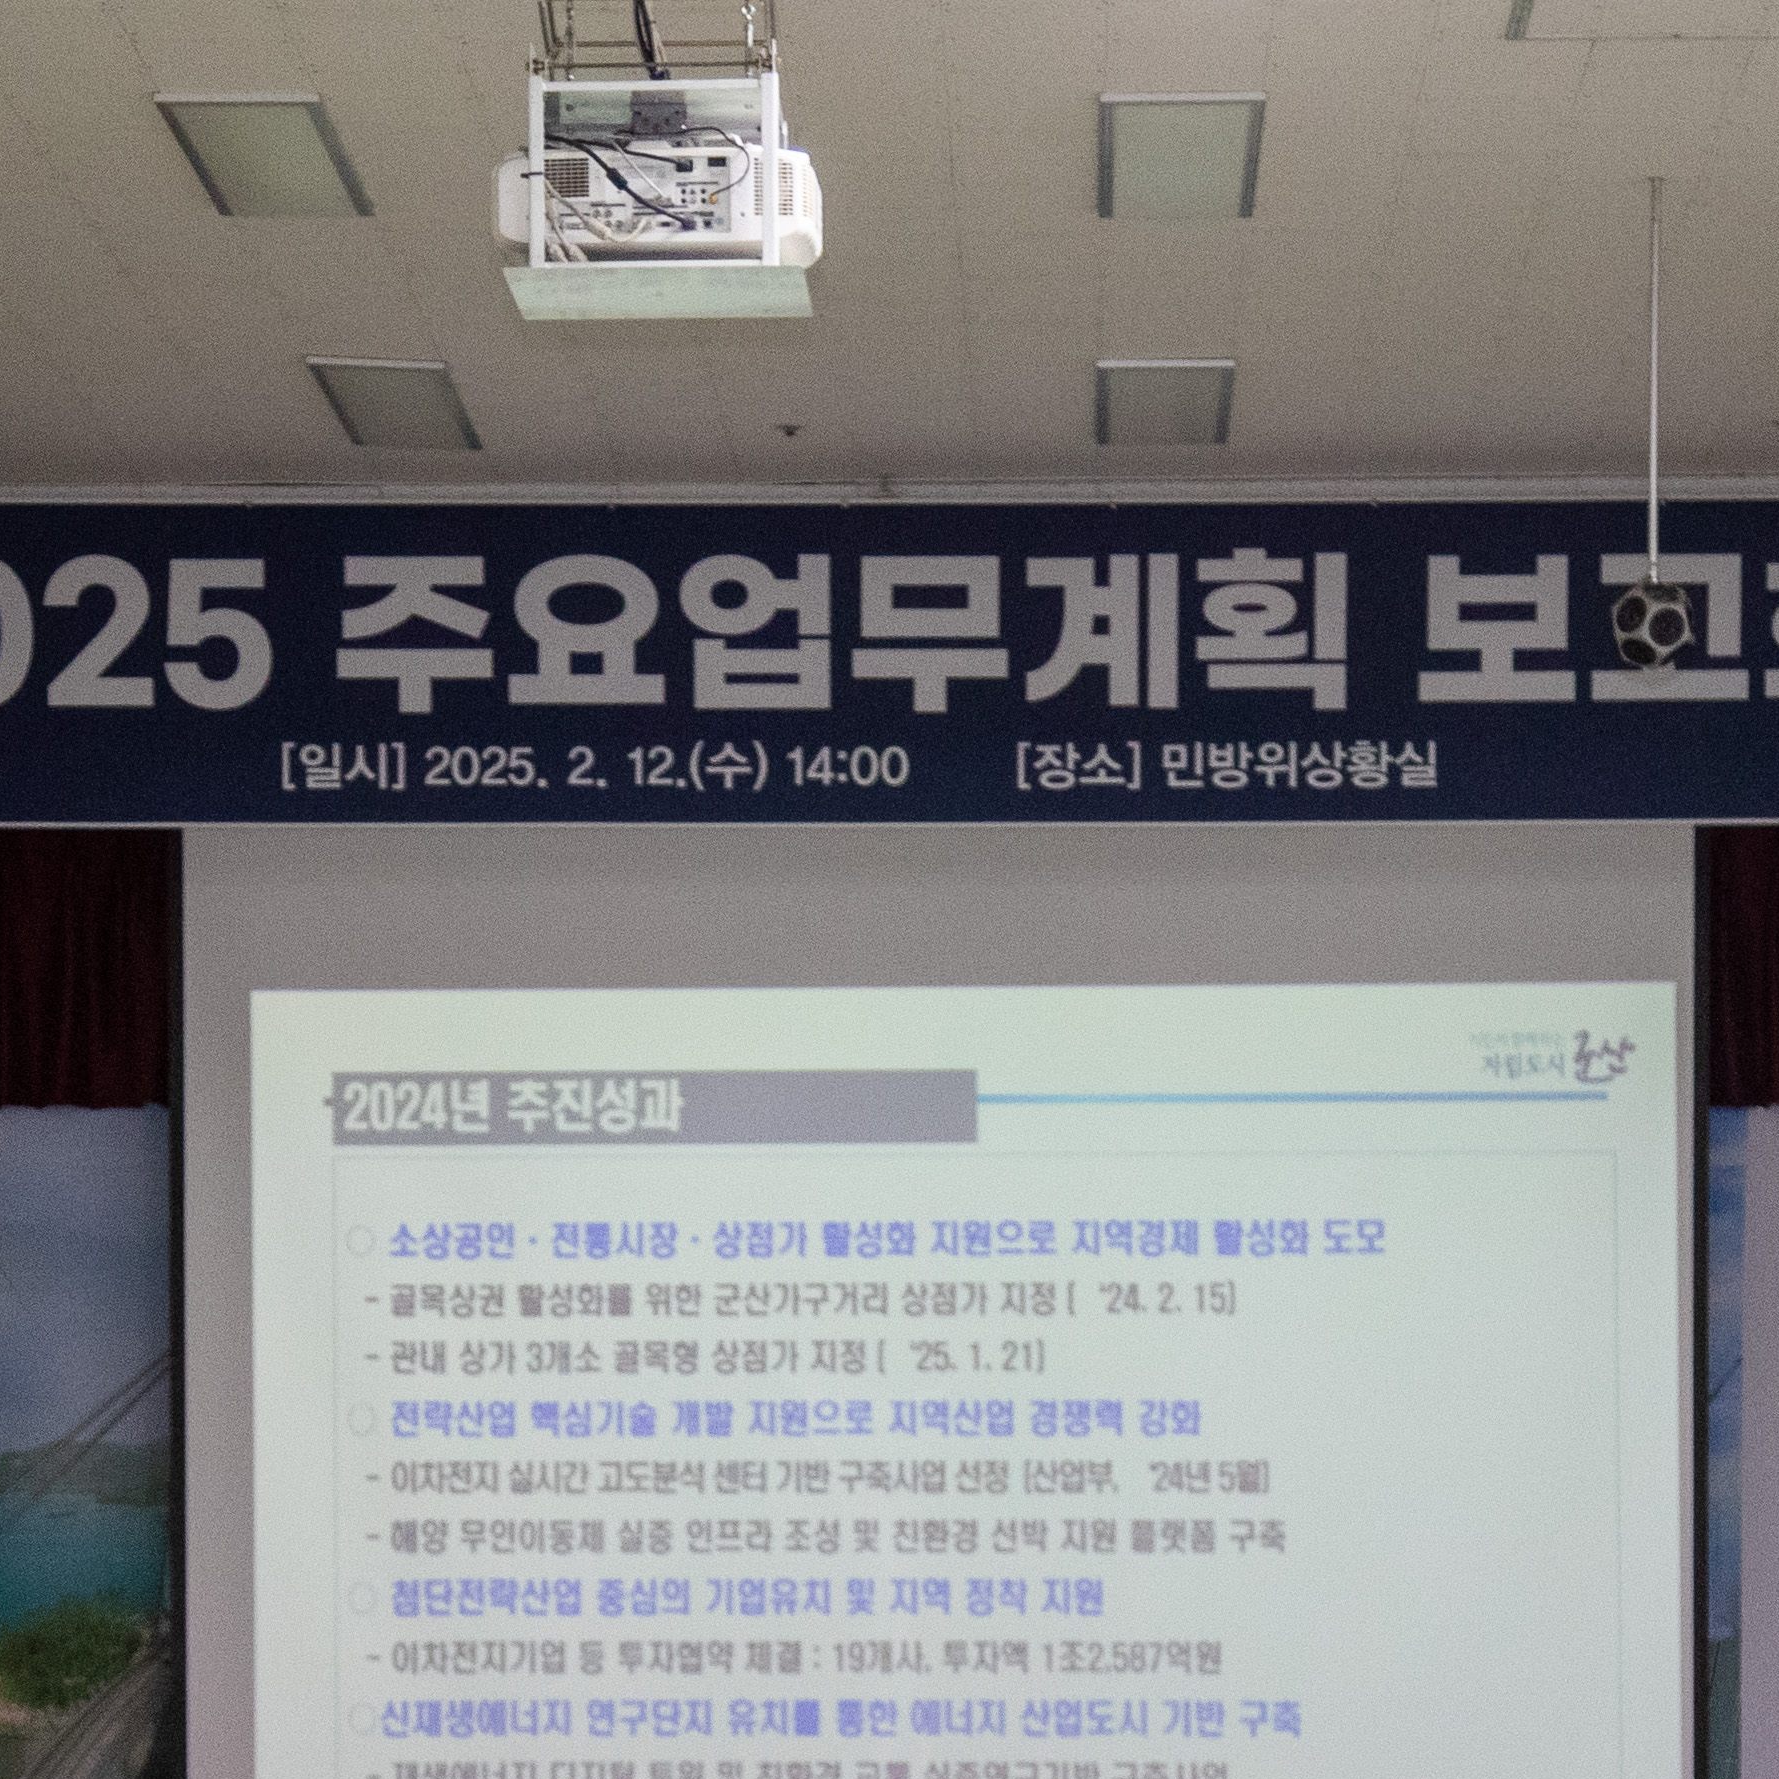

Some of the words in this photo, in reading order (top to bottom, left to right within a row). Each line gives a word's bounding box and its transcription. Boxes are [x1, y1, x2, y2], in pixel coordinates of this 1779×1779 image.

[335, 549, 1349, 713] 주요업무계획
[281, 741, 407, 791] [일시]
[424, 744, 549, 789] 2025.
[567, 745, 608, 789] 2.
[627, 740, 770, 791] 12.(수)
[787, 745, 911, 788] 14:00
[1016, 740, 1143, 791] [장소]
[1161, 739, 1439, 791] 민방위상황실
[342, 1078, 492, 1134] 2024년
[507, 1078, 685, 1135] 추진성과
[389, 1221, 516, 1262] 소상공인
[551, 1221, 679, 1261] 전통시장
[712, 1220, 809, 1261] 상점가
[821, 1220, 917, 1260] 활성화
[930, 1219, 1058, 1258] 지원으로
[1072, 1218, 1200, 1259] 지역경제
[1212, 1218, 1310, 1258] 활성화
[1323, 1218, 1386, 1256] 도모
[390, 1283, 506, 1320] 골목상권
[517, 1283, 633, 1319] 활성화를
[644, 1282, 704, 1318] 위한
[714, 1281, 890, 1318] 군산가구거리
[901, 1281, 989, 1318] 상점가
[999, 1280, 1057, 1318] 지정
[389, 1340, 447, 1376] 관내
[459, 1340, 518, 1378] 상가
[525, 1340, 602, 1376] 3개소
[614, 1339, 700, 1377] 골목형
[711, 1339, 800, 1377] 상점가
[810, 1338, 867, 1376] 지정
[390, 1399, 517, 1440] 전략산업
[530, 1400, 657, 1439] 핵심기술
[672, 1399, 735, 1438] 개발
[747, 1398, 874, 1439] 지원으로
[888, 1398, 1016, 1438] 지역산업
[1030, 1398, 1124, 1439] 경쟁력
[1139, 1398, 1203, 1439] 강화
[390, 1459, 500, 1496] 이차전지
[507, 1460, 591, 1496] 실시간
[597, 1460, 706, 1496] 고도분석
[713, 1459, 769, 1496] 센터
[776, 1459, 832, 1496] 기반
[838, 1458, 948, 1496] 구축사업
[954, 1459, 1011, 1496] 선정
[459, 1518, 606, 1557] 무인이동체
[617, 1518, 674, 1557] 실증
[684, 1518, 774, 1555] 인프라
[784, 1518, 842, 1557] 조성
[852, 1518, 881, 1554] 및
[893, 1518, 980, 1556] 친환경
[990, 1518, 1050, 1555] 선박
[1060, 1517, 1118, 1555] 지원
[1229, 1518, 1287, 1554] 구축
[391, 1577, 582, 1619] 첨단전략산업
[596, 1577, 692, 1618] 중심의
[706, 1577, 832, 1618] 기업유치
[845, 1577, 876, 1617] 및
[889, 1576, 952, 1616] 지역
[965, 1577, 1029, 1618] 정착
[1041, 1576, 1105, 1618] 지원
[390, 1639, 567, 1677] 이차전지기업
[578, 1639, 606, 1677] 등
[618, 1639, 735, 1676] 투자협약
[943, 1639, 1030, 1675] 투자액
[380, 1698, 572, 1740] 신재생에너지
[586, 1698, 714, 1739] 연구단지
[728, 1698, 821, 1738] 유치를
[909, 1698, 1007, 1737] 에너지
[1020, 1698, 1149, 1739] 산업도시
[1162, 1699, 1227, 1740] 기반
[1240, 1699, 1302, 1739] 구축
